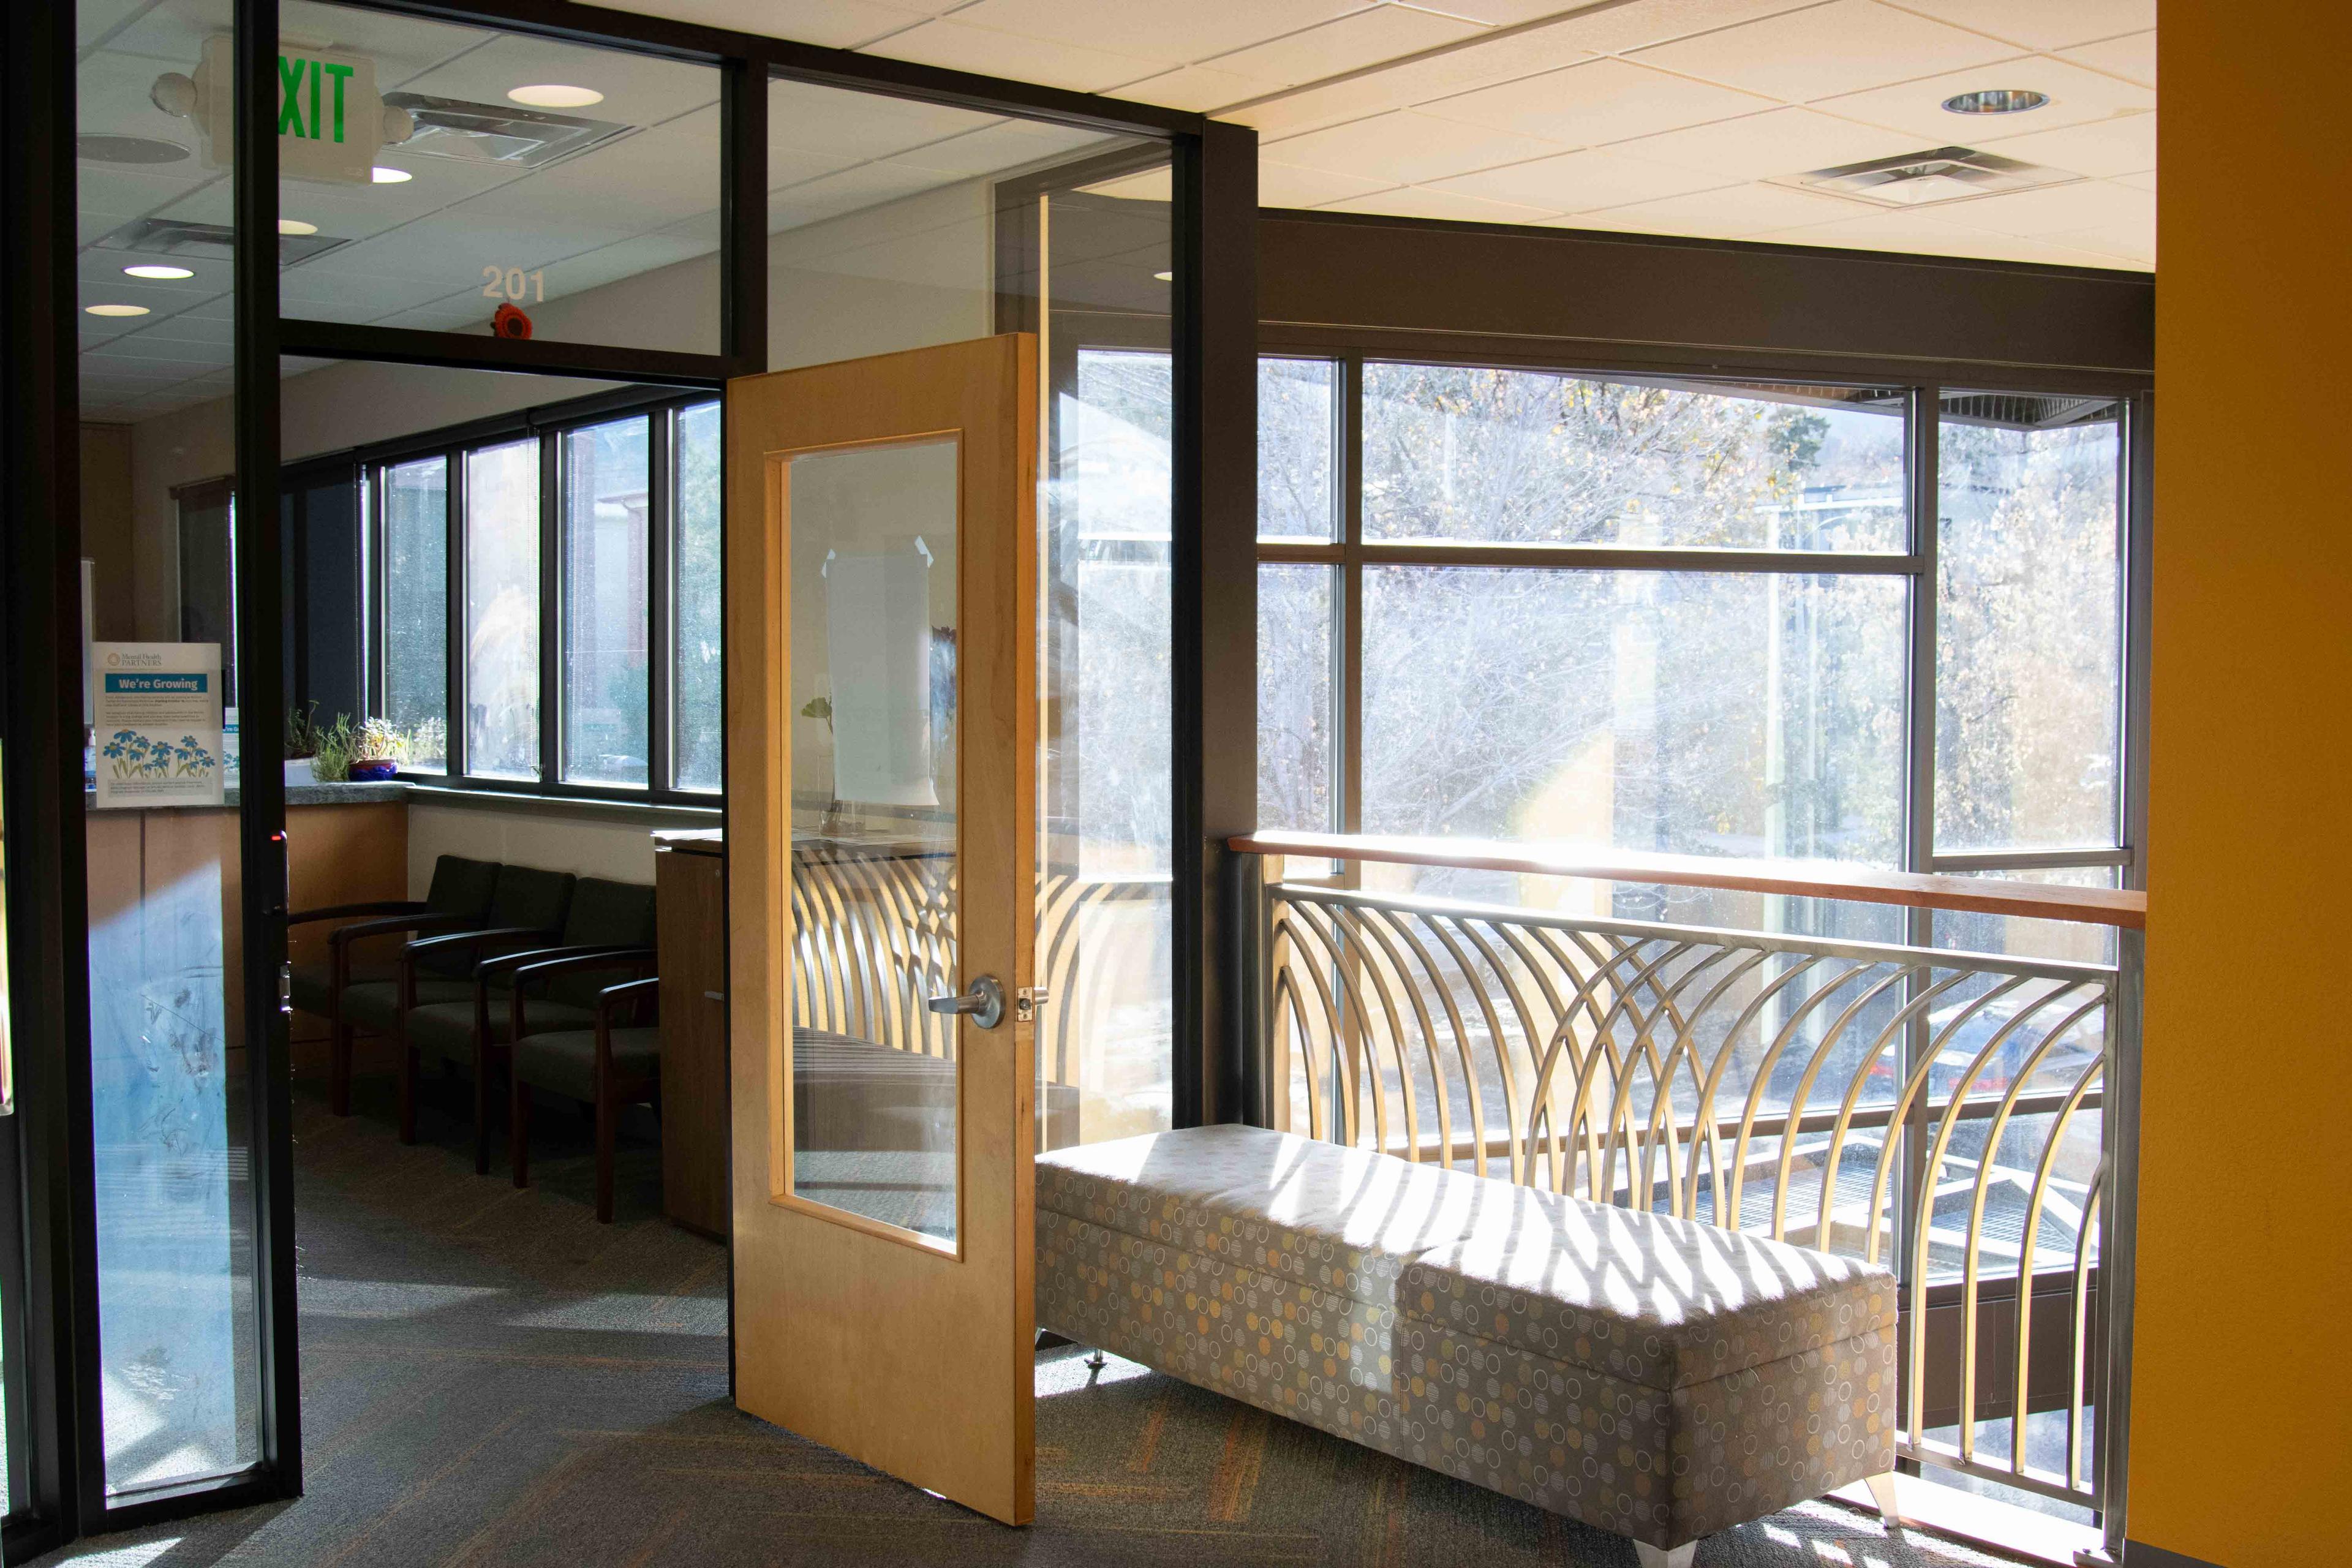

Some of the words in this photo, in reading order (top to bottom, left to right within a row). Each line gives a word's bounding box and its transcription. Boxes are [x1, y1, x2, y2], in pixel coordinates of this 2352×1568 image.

[279, 56, 353, 143] XIT
[483, 265, 543, 302] 201
[119, 679, 151, 688] We're
[154, 678, 198, 691] Growing
